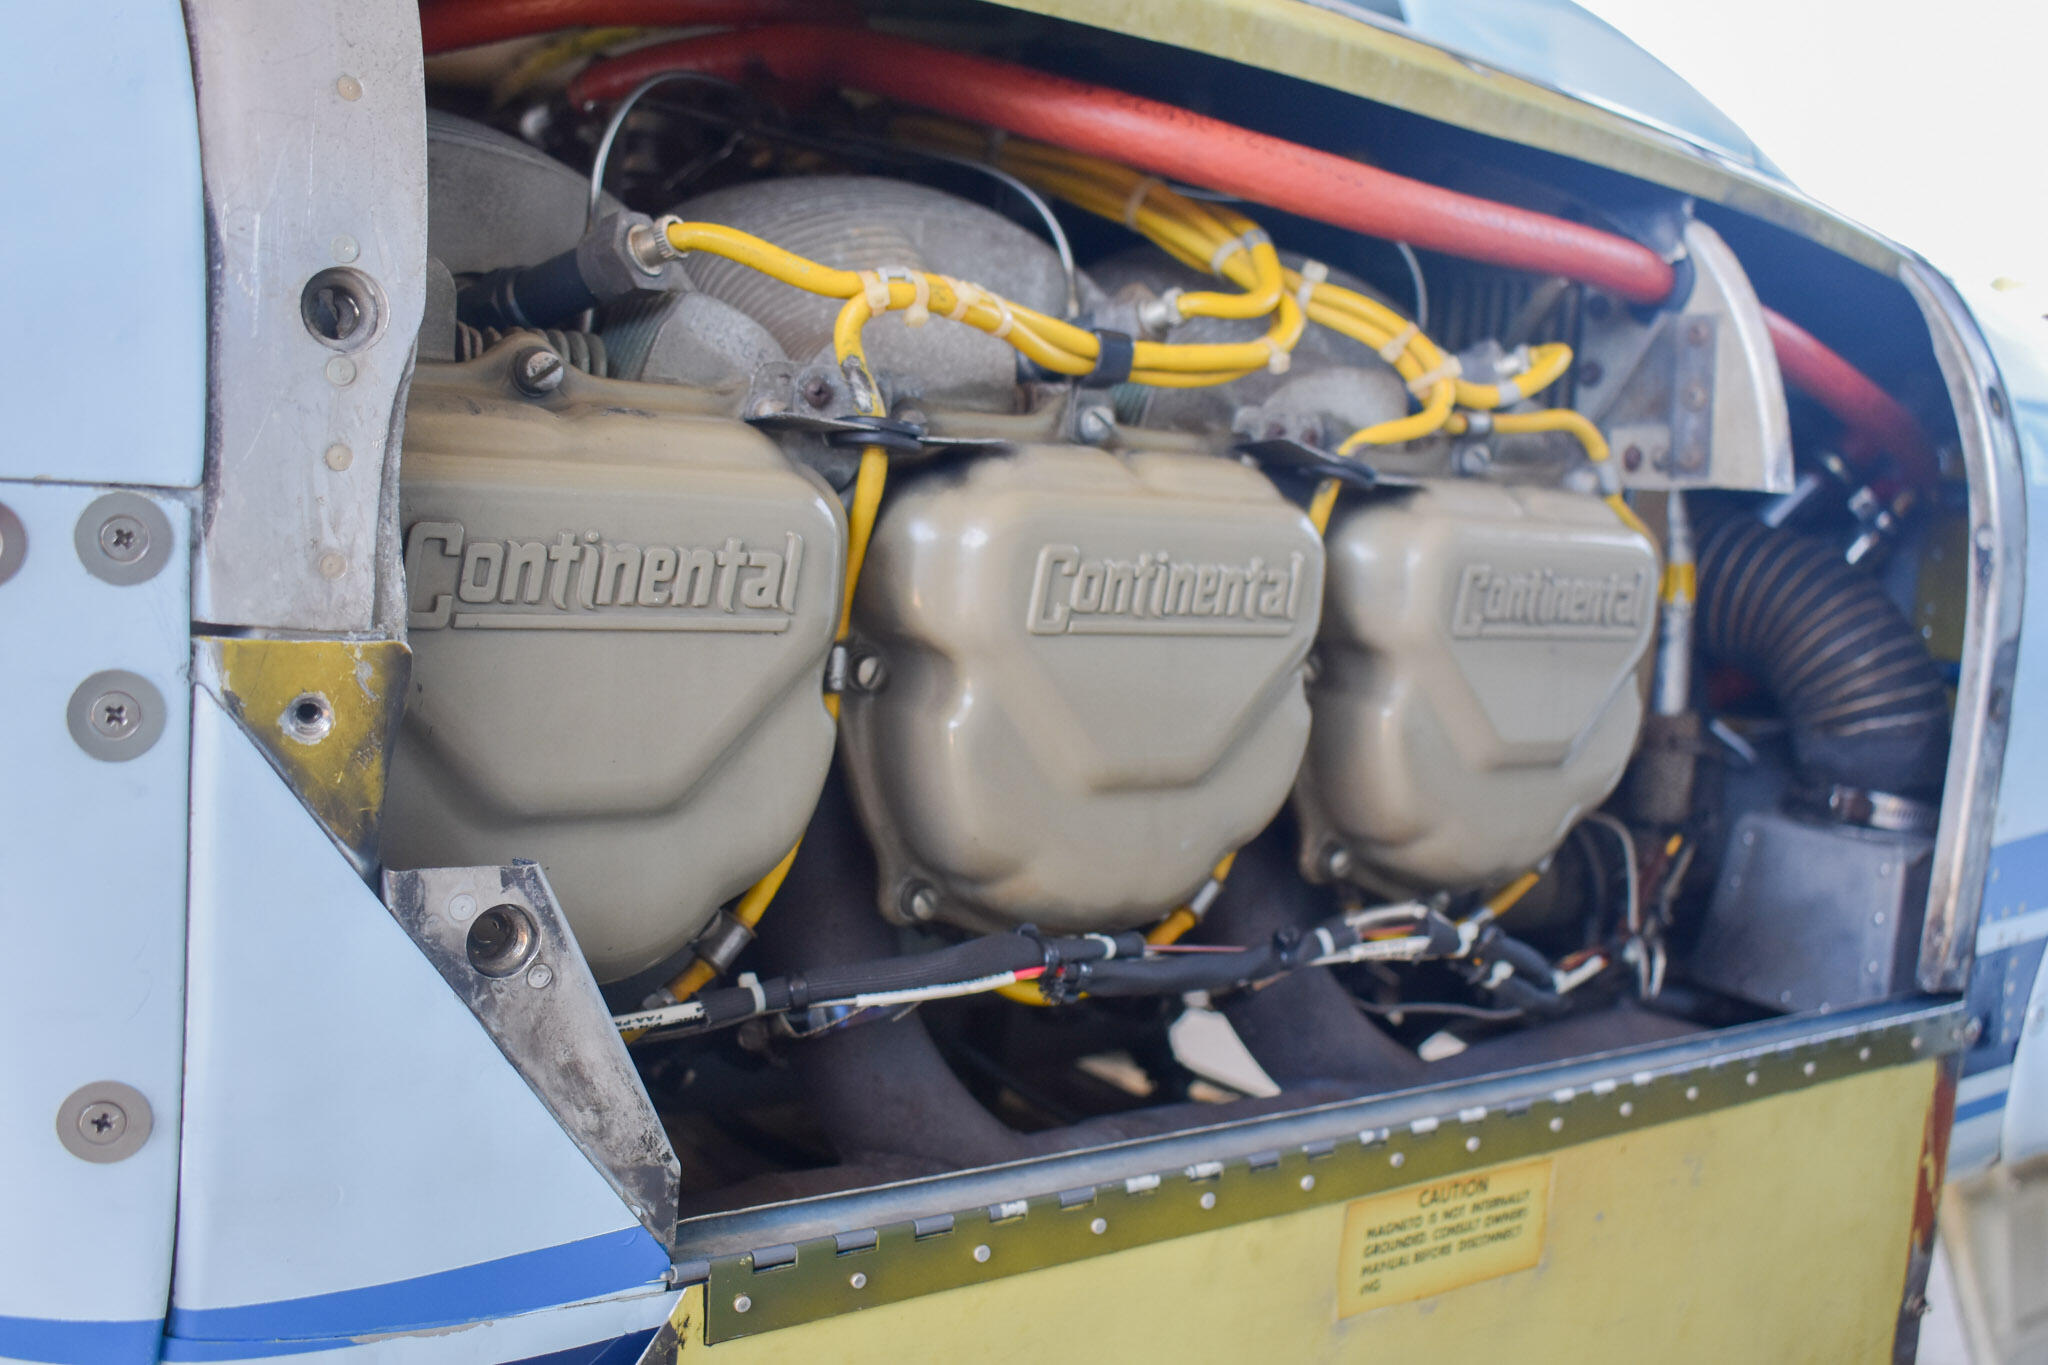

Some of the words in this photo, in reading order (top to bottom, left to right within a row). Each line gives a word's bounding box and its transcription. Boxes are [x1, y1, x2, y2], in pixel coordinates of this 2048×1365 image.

[404, 520, 804, 631] Continental
[1026, 543, 1305, 636] Continental
[1452, 564, 1647, 639] Continental
[1418, 1177, 1489, 1208] CAUTION
[1366, 1215, 1424, 1239] MAGNETO
[1443, 1205, 1466, 1221] NOT
[1432, 1217, 1481, 1241] CONSULT
[1360, 1255, 1410, 1277] MANUAL
[1414, 1243, 1452, 1263] BEFORE
